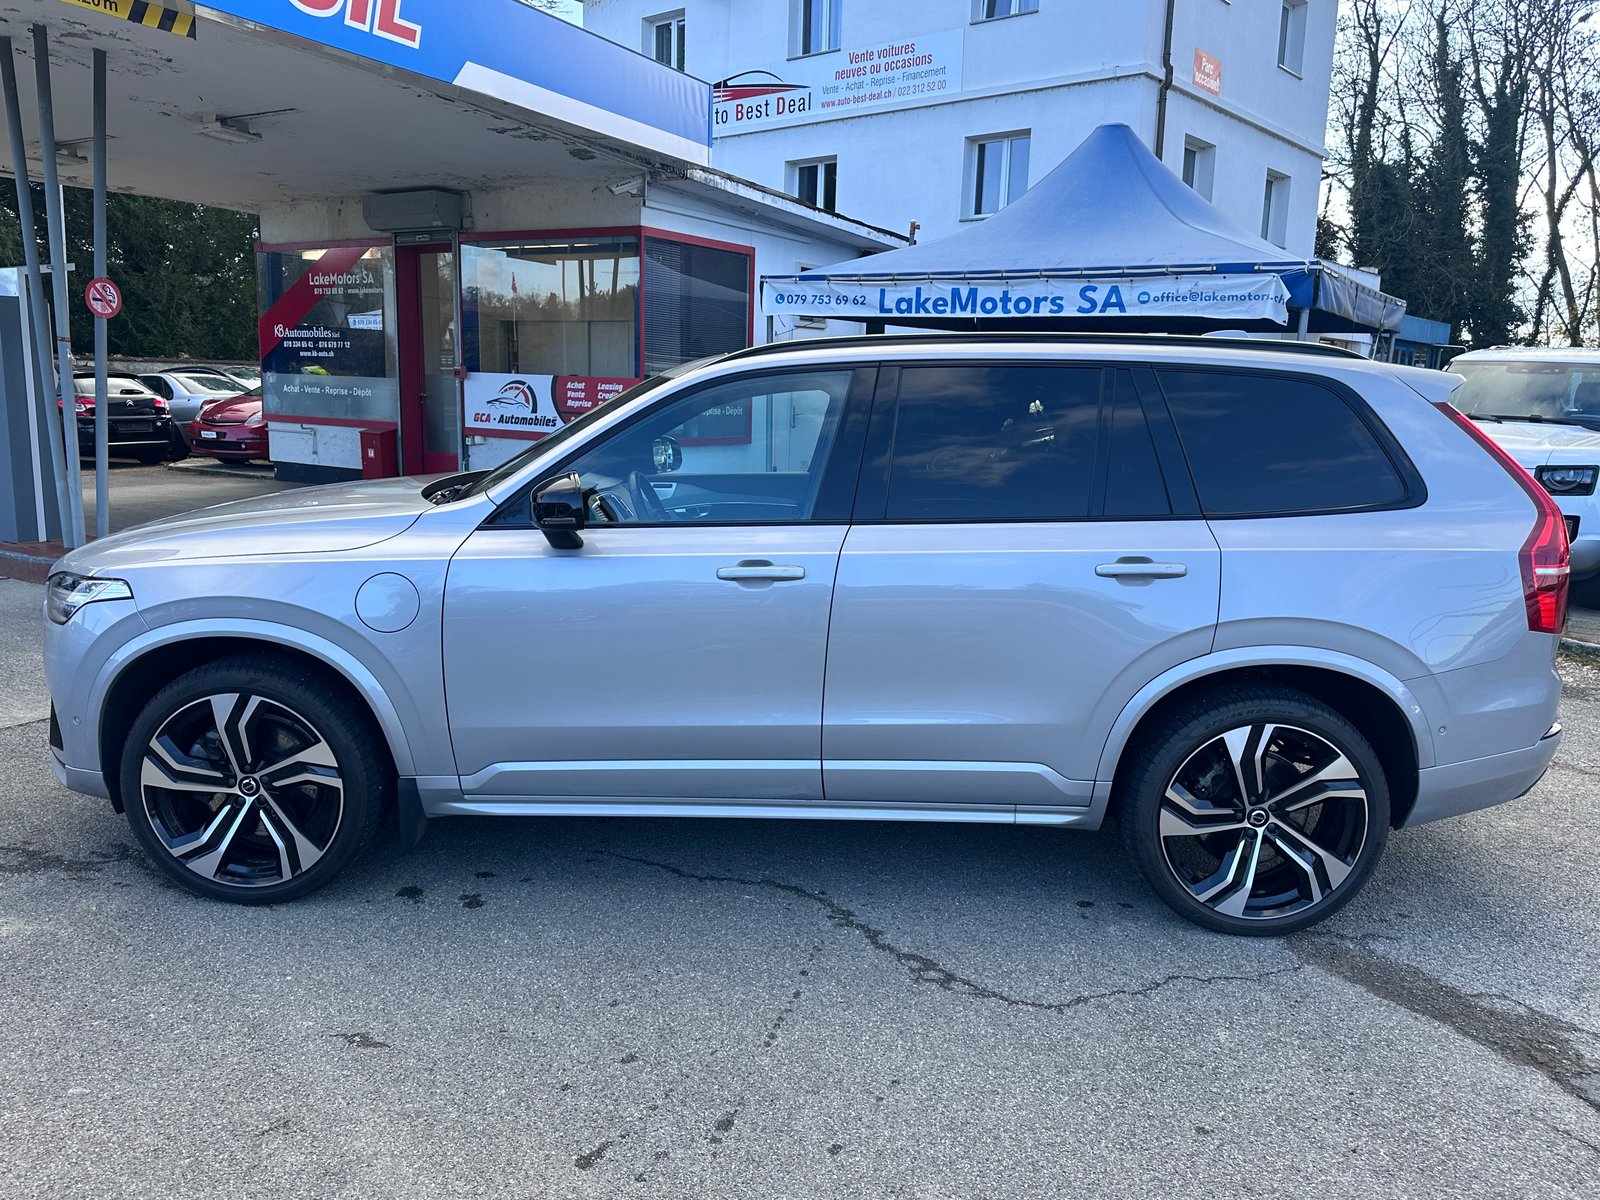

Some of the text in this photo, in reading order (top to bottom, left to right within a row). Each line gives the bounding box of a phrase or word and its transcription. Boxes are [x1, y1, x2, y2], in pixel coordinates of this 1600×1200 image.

[288, 0, 422, 50] IL
[849, 42, 916, 64] Vente voitures
[835, 53, 933, 80] neuves ou occasions
[1201, 57, 1213, 74] Parc
[822, 84, 840, 95] Vente
[845, 80, 864, 92] Achat
[871, 74, 896, 88] Reprise
[902, 65, 947, 82] Financement
[820, 89, 892, 109] www.auto-best-deal.ch
[898, 85, 911, 97] 022
[912, 83, 925, 95] 312
[927, 82, 935, 92] 52
[937, 80, 947, 90] 00
[736, 100, 769, 121] Best
[777, 92, 811, 115] Deal
[309, 271, 374, 285] LakeMotors SA
[787, 284, 1286, 315] 079 753 69 62 LakeMotors SA office@lakemotors.ch
[284, 327, 332, 338] Automobiles
[283, 385, 300, 393] Achat
[304, 385, 320, 394] Vente
[326, 386, 348, 396] Reprise
[353, 387, 372, 397] Dépôt
[597, 383, 623, 392] Leasing
[567, 400, 592, 408] Reprise
[726, 406, 742, 416] Dépôt
[474, 413, 491, 423] GCA
[498, 414, 557, 427] Automobiles
